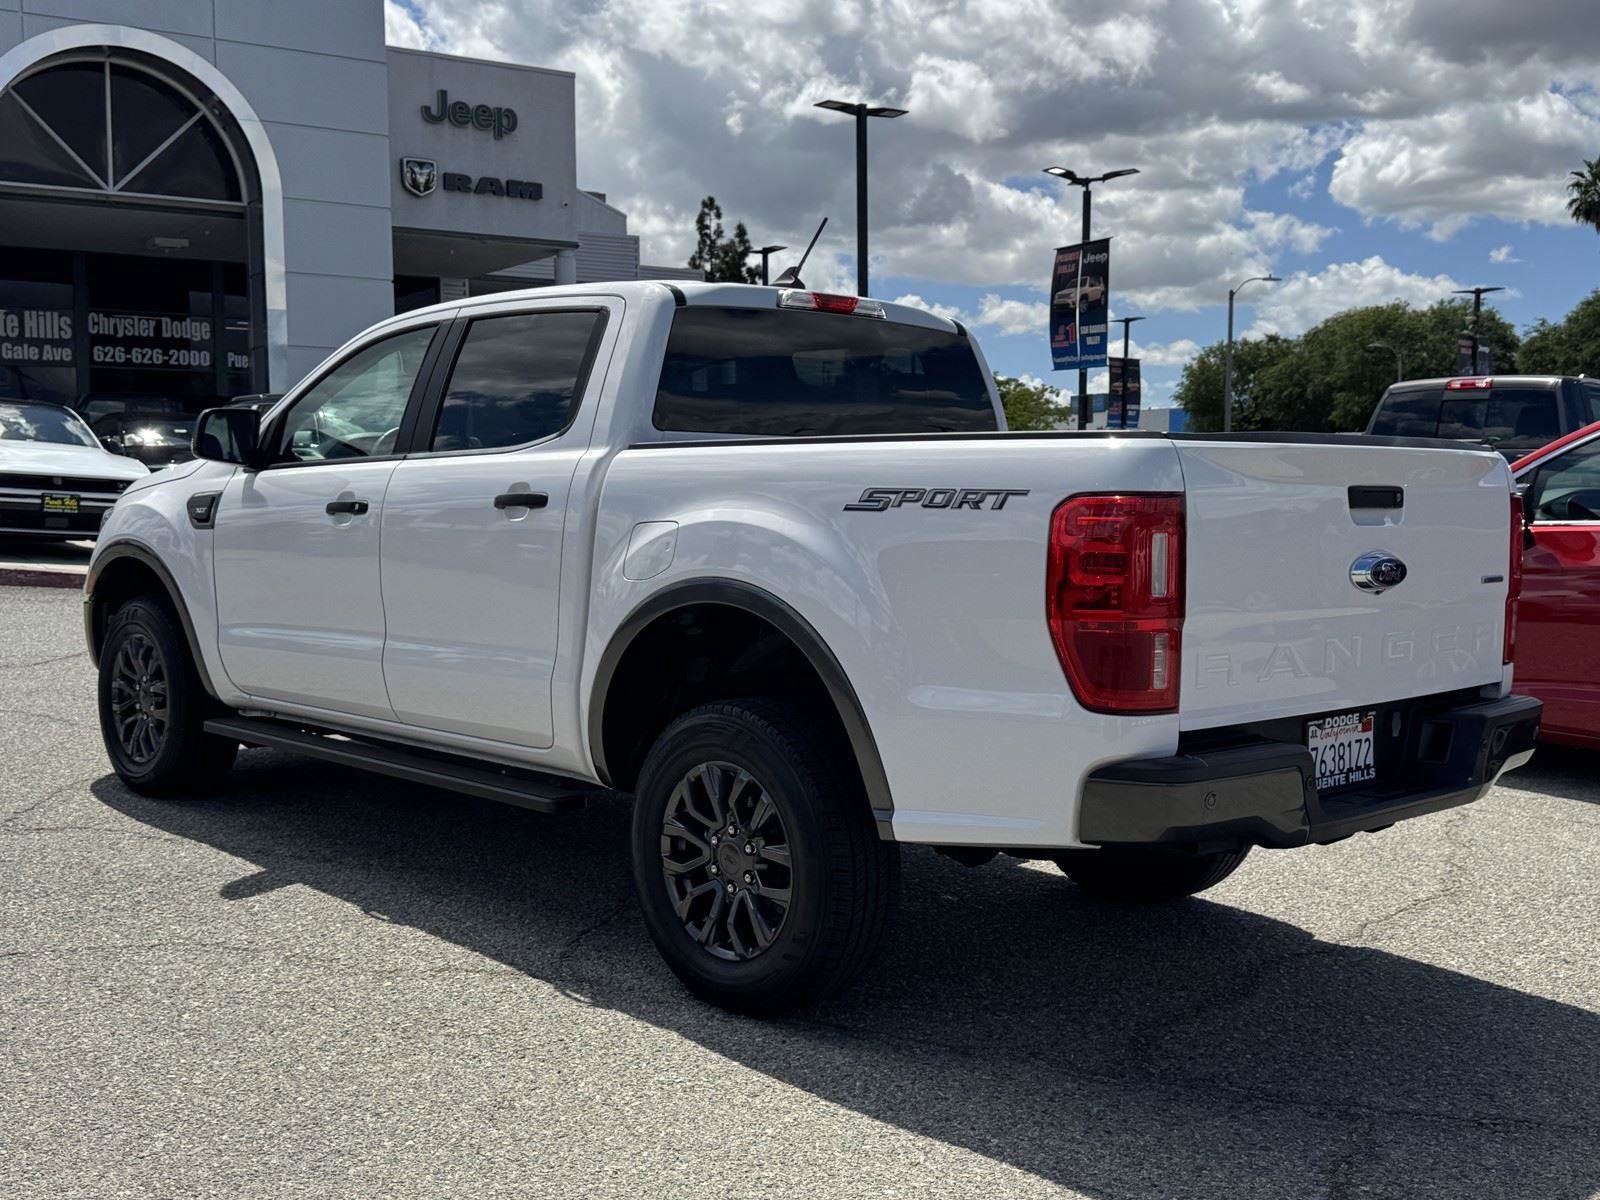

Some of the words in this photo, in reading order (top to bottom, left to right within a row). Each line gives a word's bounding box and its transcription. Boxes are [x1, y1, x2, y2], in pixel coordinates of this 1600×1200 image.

[420, 89, 518, 140] Jeep
[442, 172, 543, 200] RAM
[1083, 252, 1107, 264] Jeep
[24, 310, 73, 340] Hills
[88, 312, 156, 337] Chrysler
[161, 317, 211, 341] Dodge
[1, 342, 40, 360] Gale
[42, 344, 73, 361] Ave
[93, 345, 211, 367] 626-626-2000
[227, 352, 249, 368] Pue
[842, 487, 1031, 512] SPORT
[1195, 622, 1500, 690] RANGER
[1325, 713, 1360, 728] DODGE
[1349, 768, 1376, 783] HILLS
